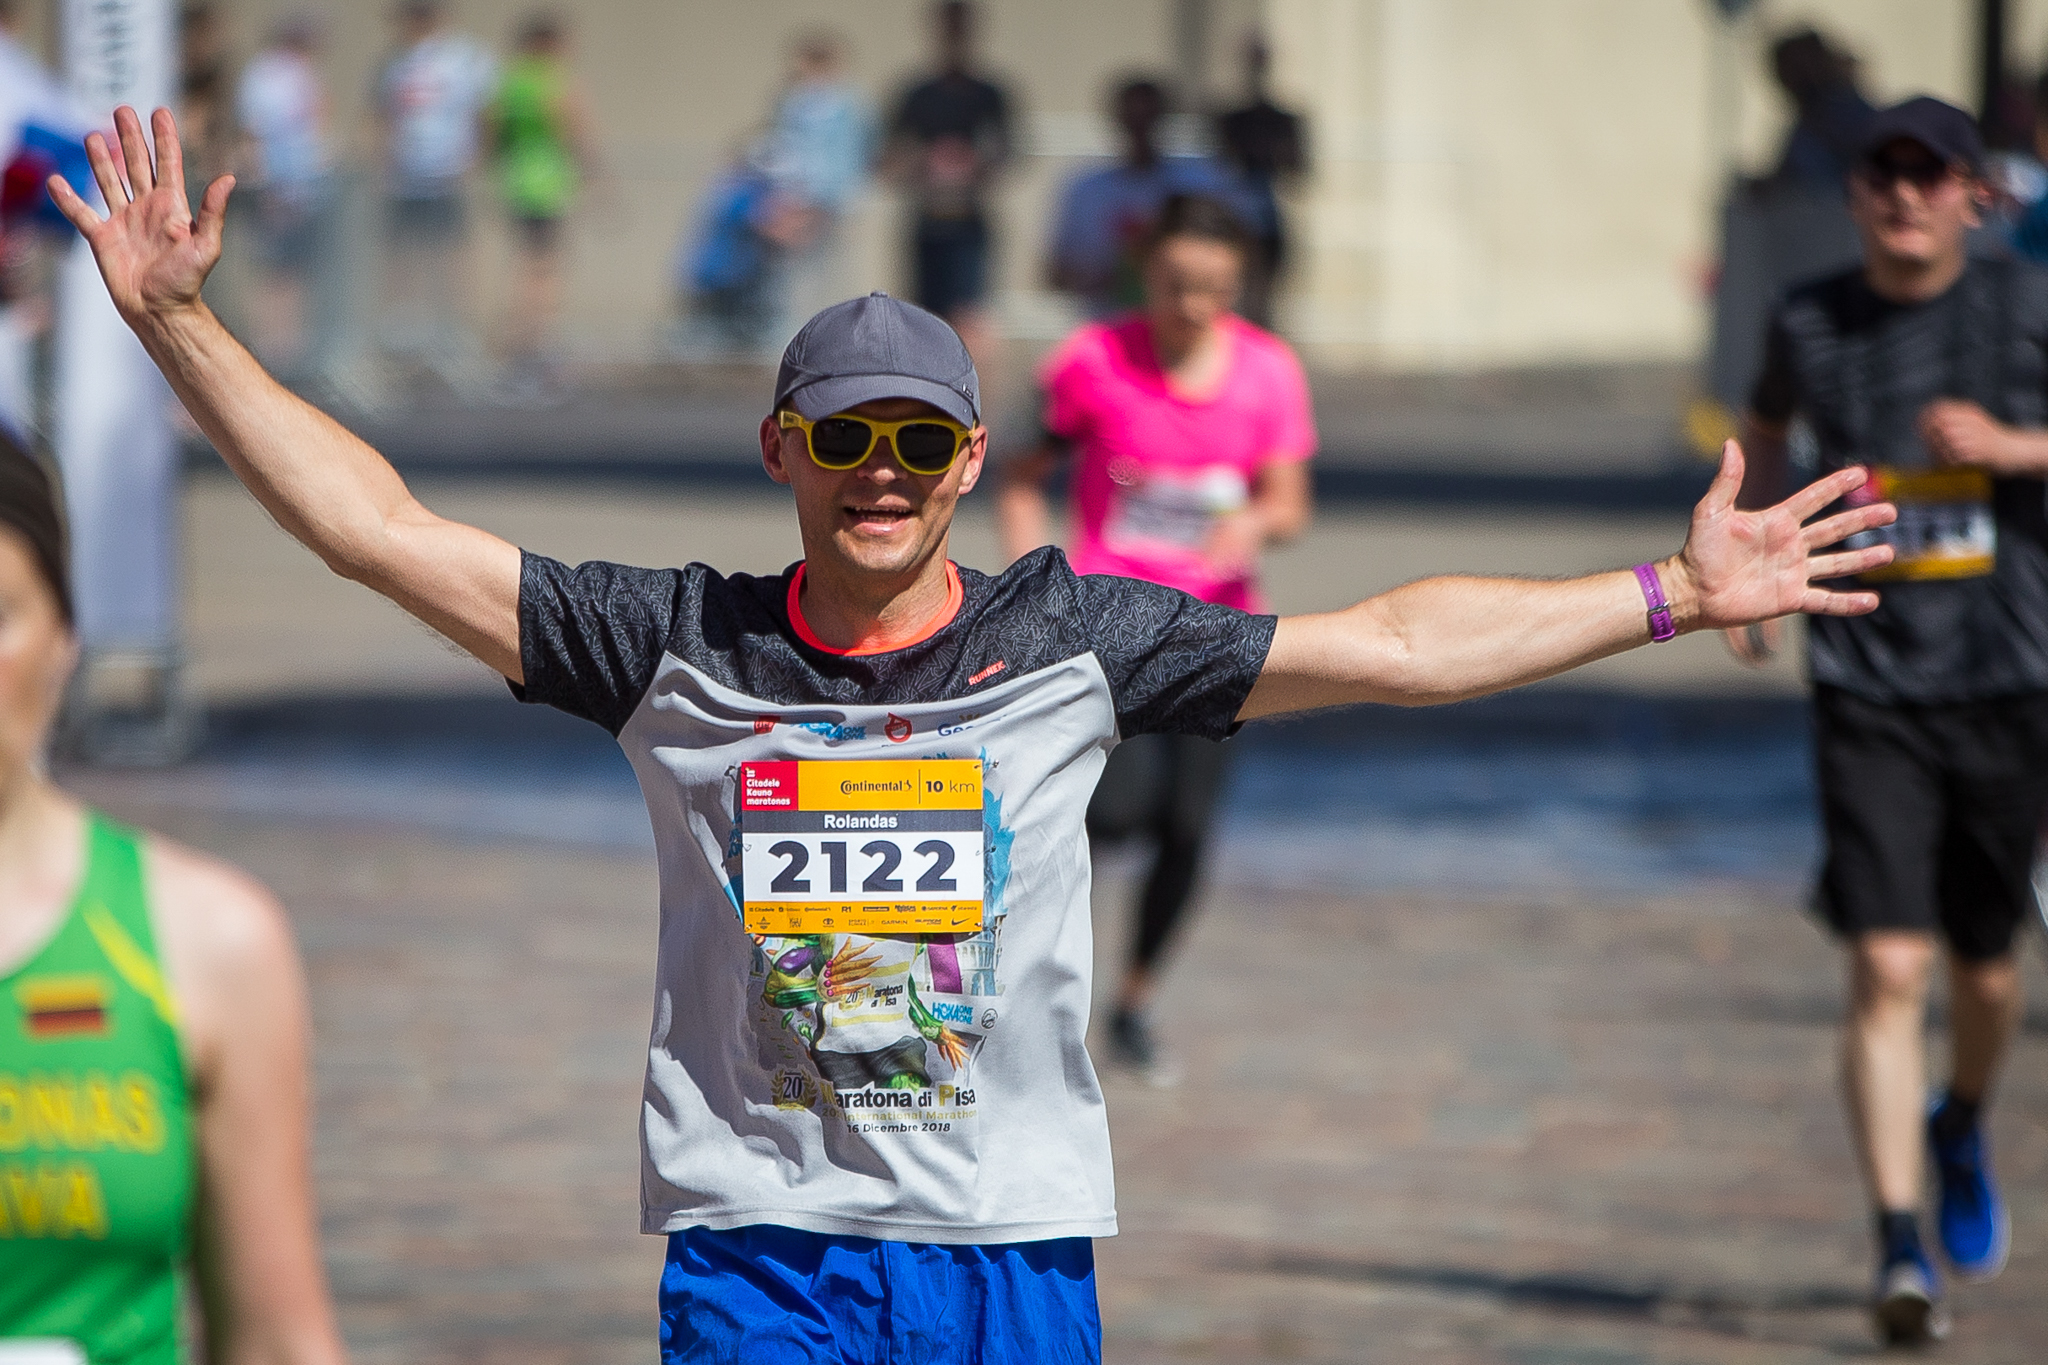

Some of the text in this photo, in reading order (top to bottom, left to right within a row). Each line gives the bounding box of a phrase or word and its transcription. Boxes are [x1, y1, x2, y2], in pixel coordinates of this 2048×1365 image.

[746, 779, 780, 788] Citadele
[840, 780, 903, 795] Continental
[926, 780, 975, 793] 10 km
[746, 788, 773, 797] Kauno
[746, 798, 791, 806] maratonas
[824, 814, 898, 829] Rolandas
[768, 840, 957, 893] 2122
[918, 1091, 932, 1107] di
[938, 1084, 976, 1108] Pisa
[847, 1122, 951, 1133] 16 Dicembre 2018
